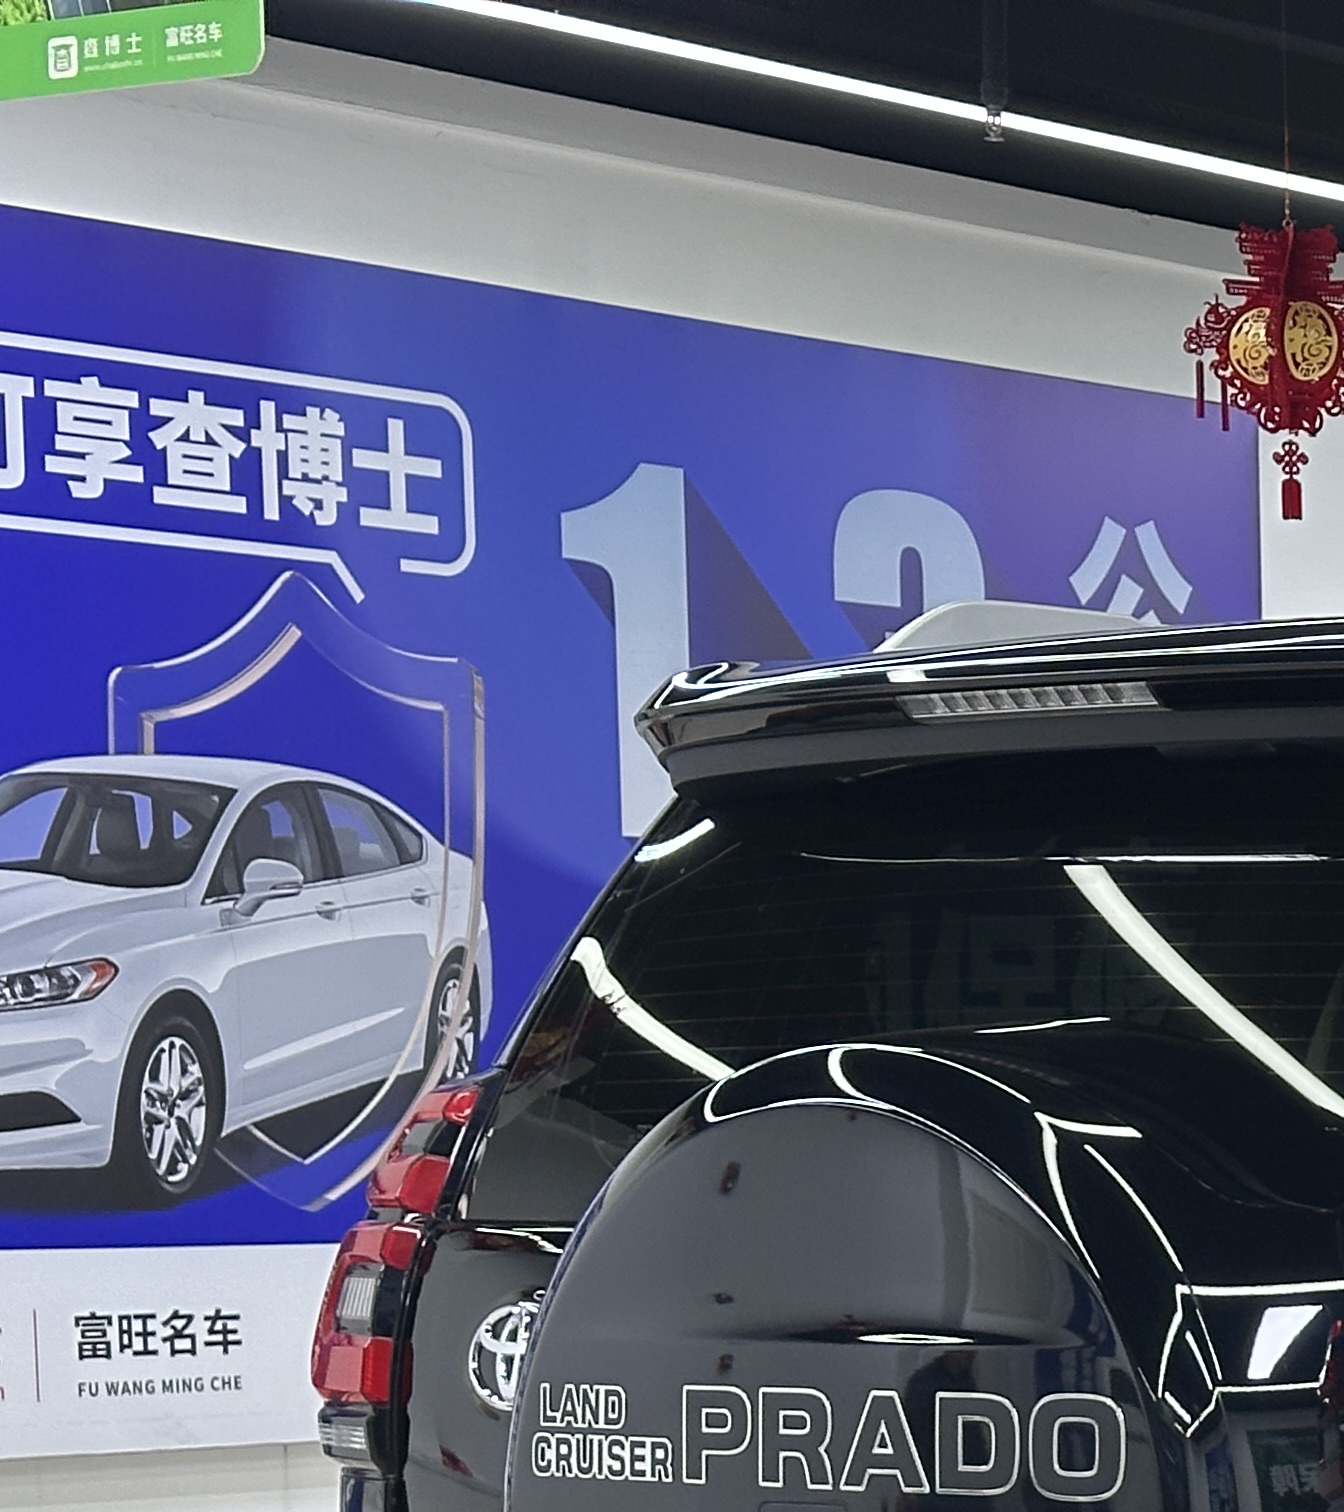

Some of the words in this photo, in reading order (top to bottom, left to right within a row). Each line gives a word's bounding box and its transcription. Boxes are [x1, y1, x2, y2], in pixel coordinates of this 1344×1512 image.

[165, 22, 222, 47] 富旺名车
[74, 1307, 243, 1361] 富旺名车
[78, 1382, 99, 1398] FU
[105, 1379, 156, 1397] WANG
[161, 1376, 205, 1394] MING
[210, 1375, 243, 1392] CHE
[540, 1383, 627, 1430] LAND
[532, 1433, 674, 1482] CRUISER
[682, 1385, 1126, 1501] PRADO
